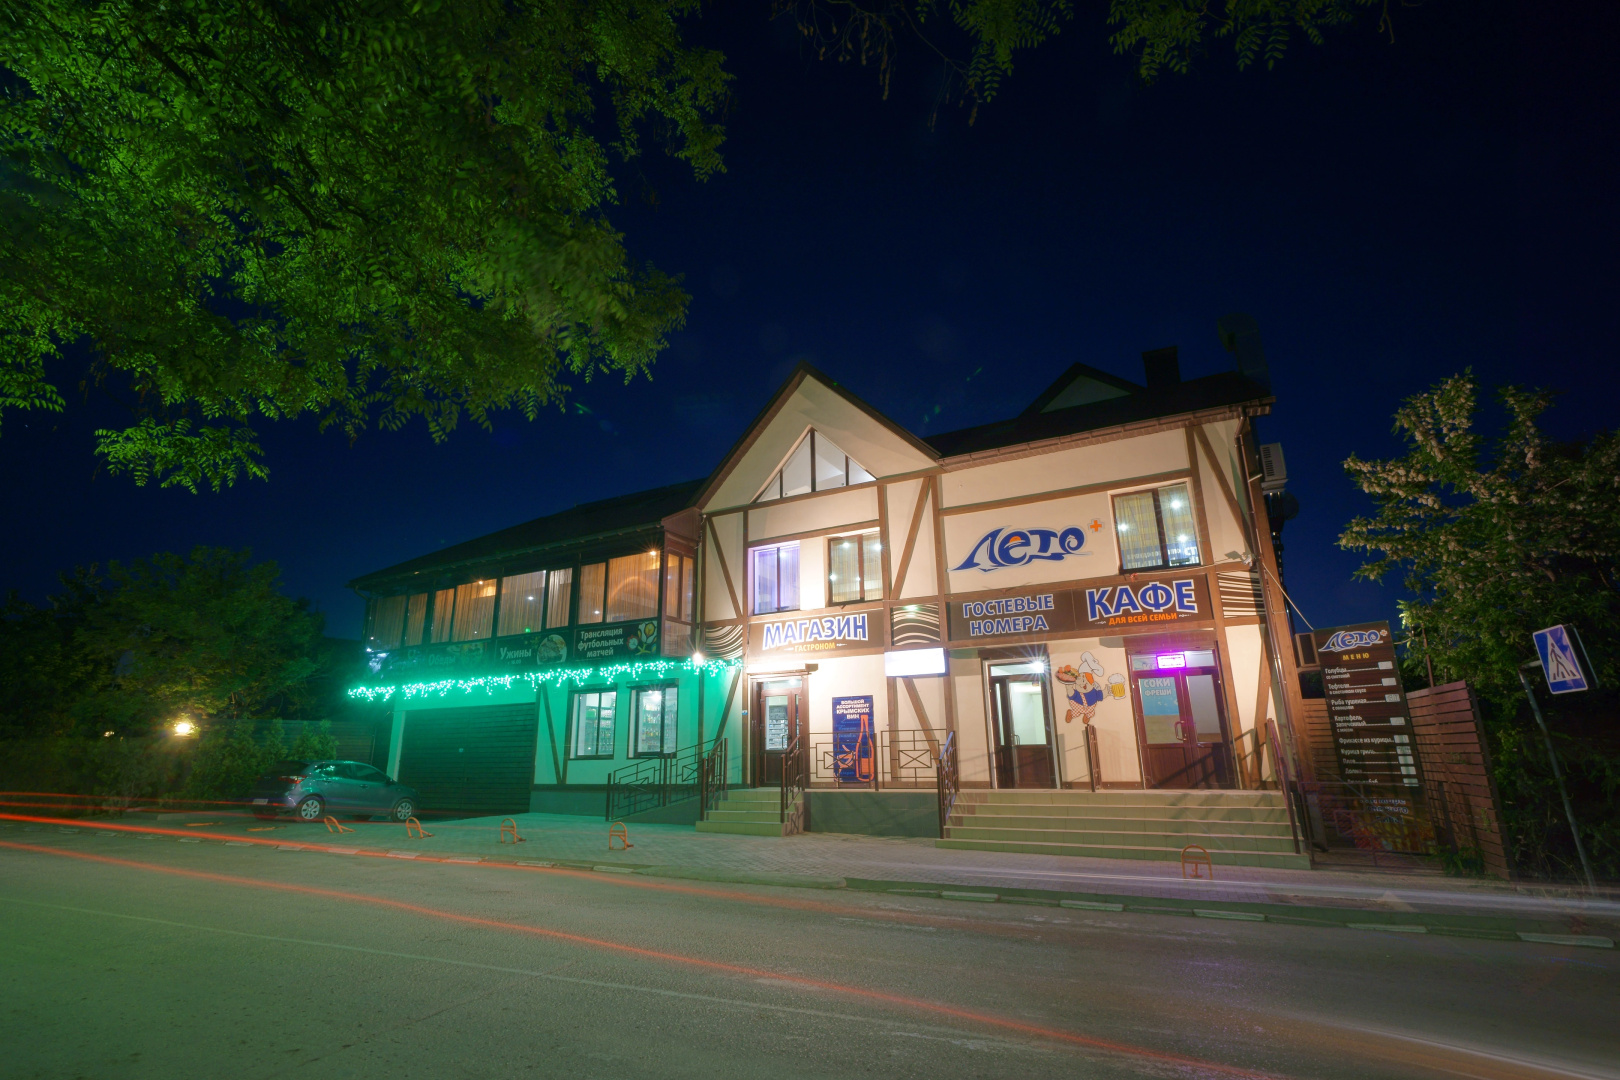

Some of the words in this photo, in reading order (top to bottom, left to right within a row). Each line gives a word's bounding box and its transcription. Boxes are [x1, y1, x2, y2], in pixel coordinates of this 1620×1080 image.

[963, 593, 1054, 618] ГОСТЕВЫЕ
[1086, 579, 1198, 621] КАФЕ
[970, 615, 1049, 636] НОМЕРА
[1108, 615, 1126, 626] ДЛЯ
[1128, 612, 1148, 624] ВСЕЙ
[1149, 612, 1177, 623] СЕМЬИ
[580, 628, 623, 640] Трансляция
[762, 613, 868, 651] МАГАЗИН
[577, 637, 624, 651] футбольных
[794, 642, 836, 652] ГАСТРОНОМ
[500, 647, 532, 660] Ужины
[587, 647, 614, 658] матчей
[1143, 678, 1171, 687] СОКИ
